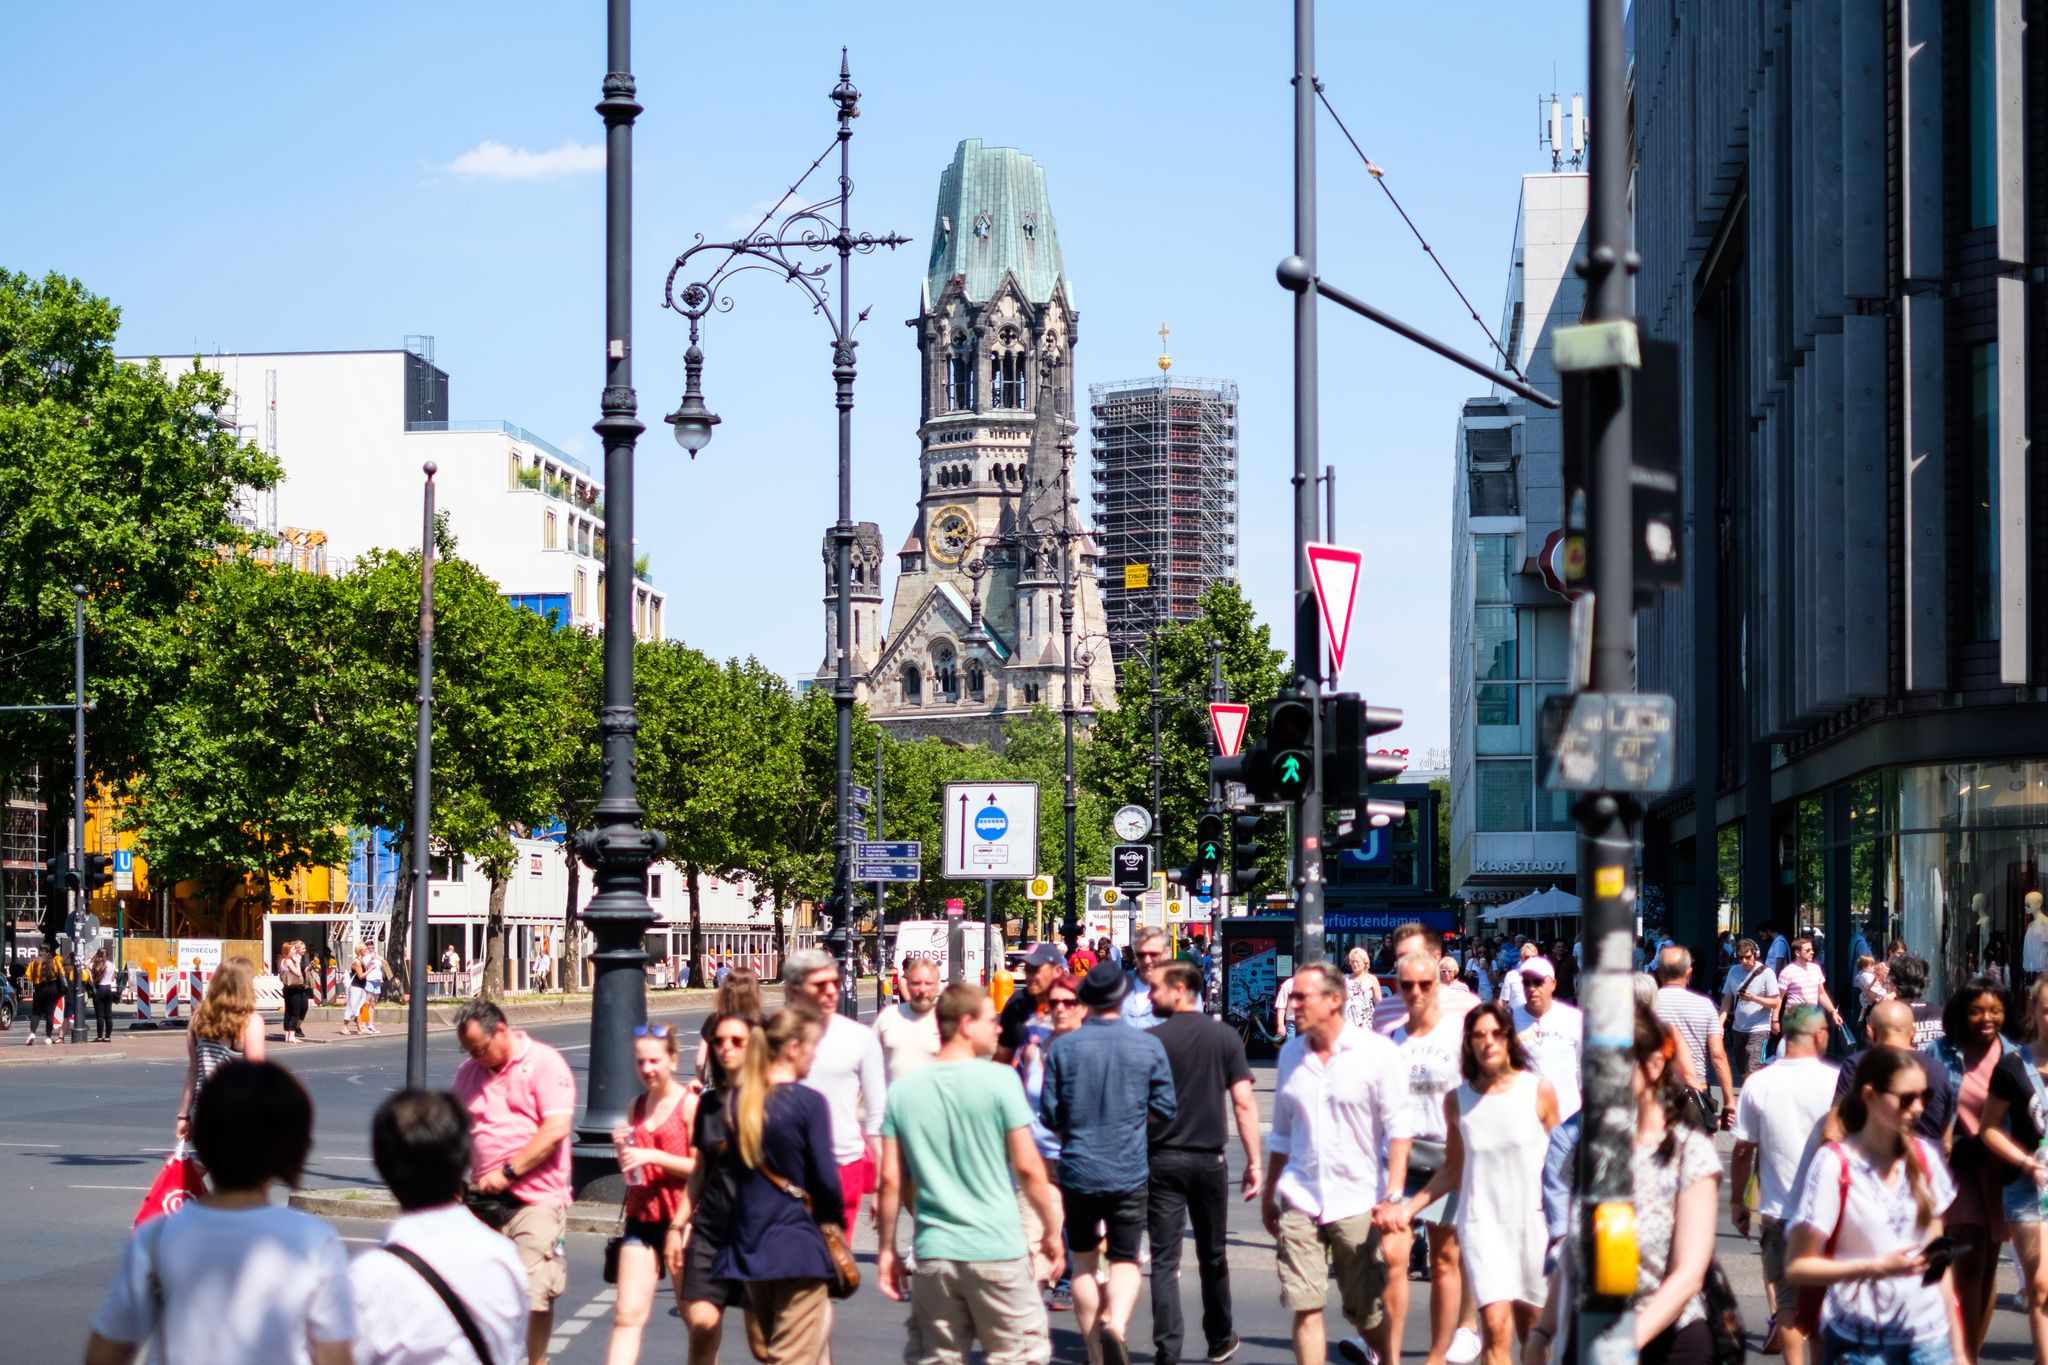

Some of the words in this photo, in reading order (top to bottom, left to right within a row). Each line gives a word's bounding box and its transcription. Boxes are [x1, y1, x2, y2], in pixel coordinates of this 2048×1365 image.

[120, 852, 131, 870] U
[1476, 860, 1566, 872] KARSTADT
[1035, 882, 1044, 893] H
[1107, 892, 1115, 901] H
[1468, 891, 1530, 901] KARSTA
[1324, 913, 1420, 928] urfürstendamm
[905, 950, 975, 961] PROSER
